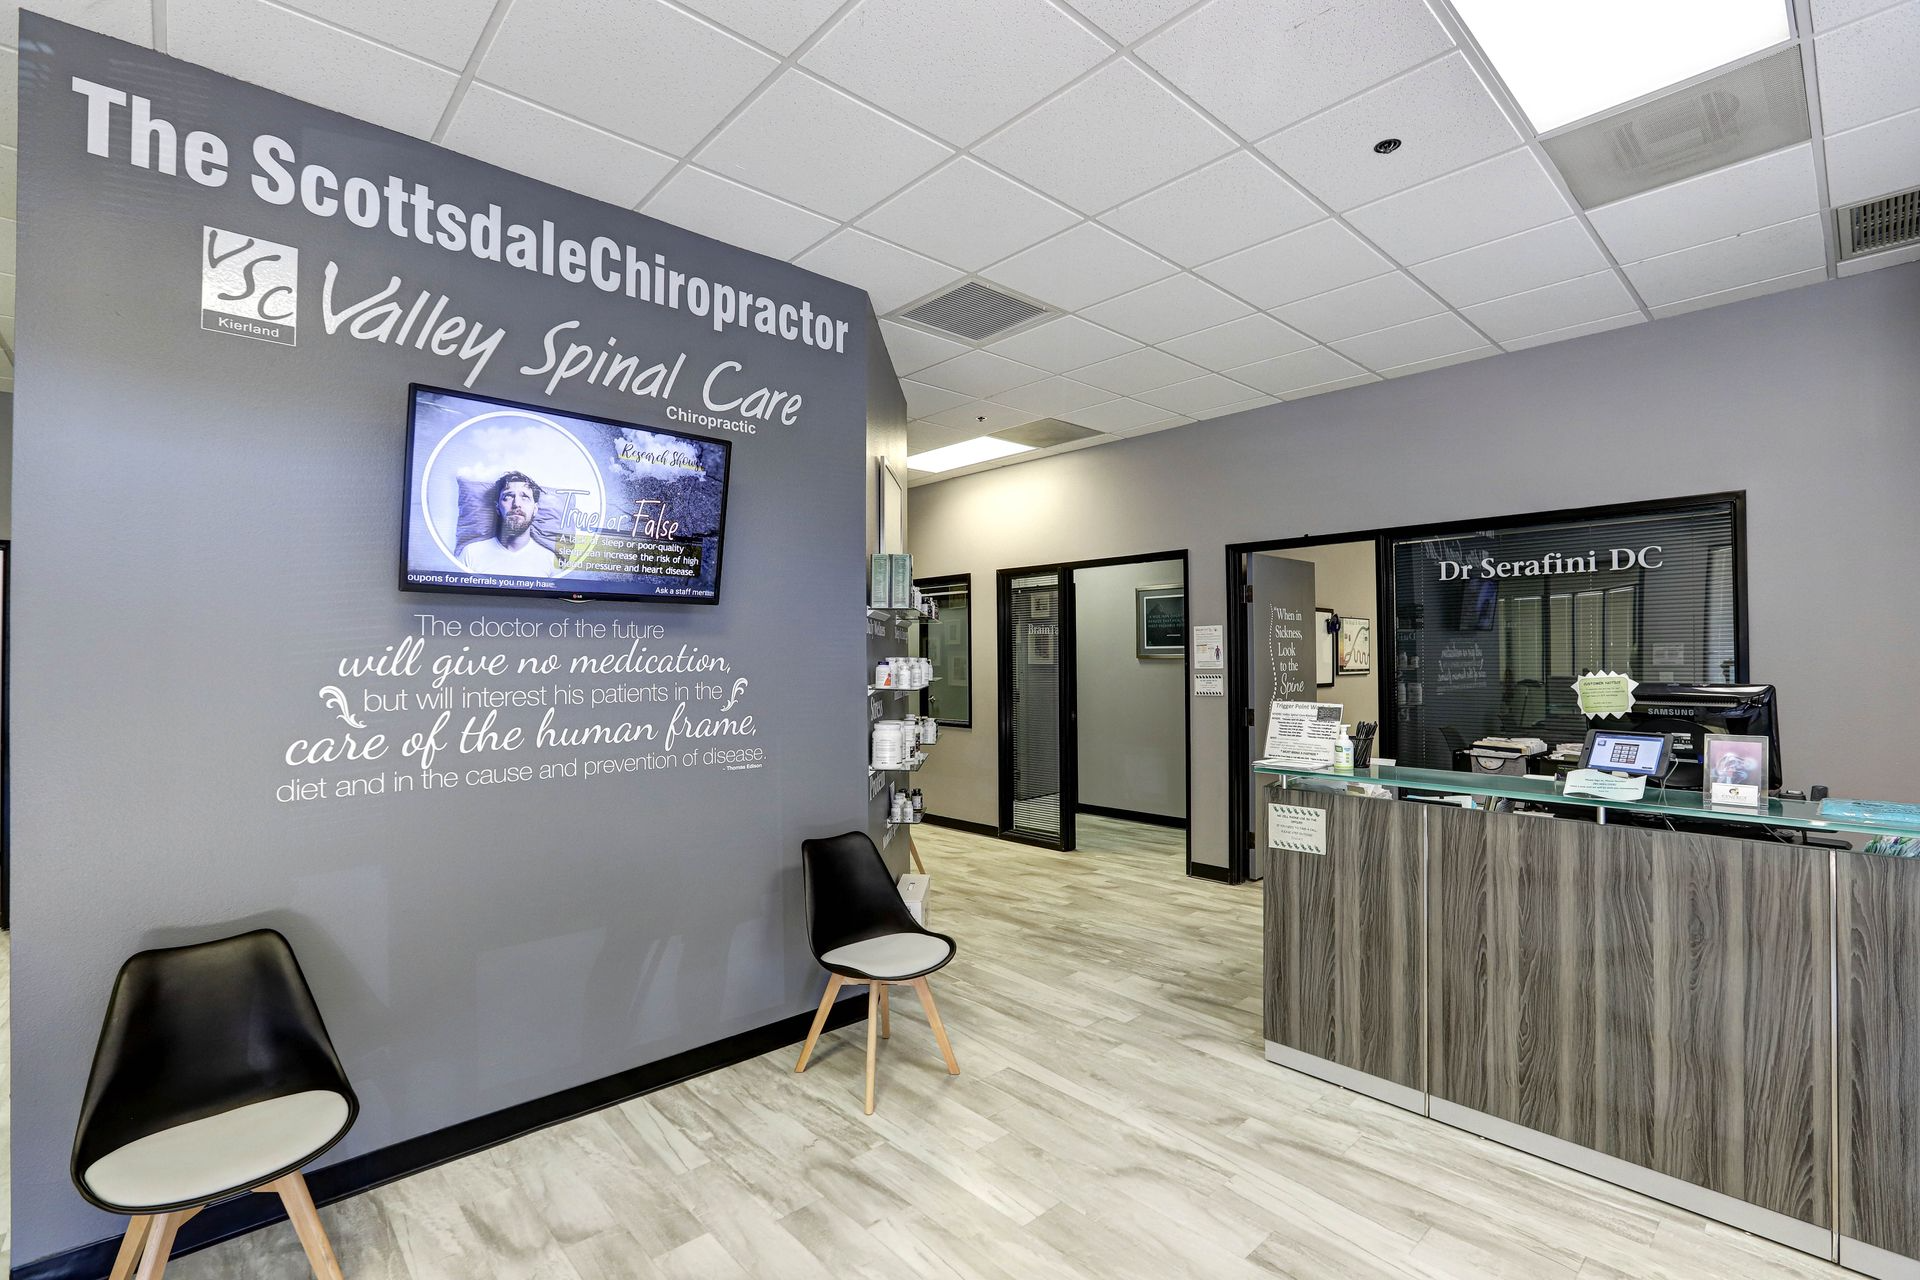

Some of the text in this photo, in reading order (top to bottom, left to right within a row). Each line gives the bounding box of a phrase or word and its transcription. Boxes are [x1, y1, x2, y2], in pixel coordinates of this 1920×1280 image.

[71, 75, 229, 188] The
[218, 317, 280, 338] Kierland
[322, 260, 803, 426] Valley Spinal Care
[666, 405, 757, 435] Chiropractic
[621, 443, 669, 466] Research
[556, 489, 680, 541] True or False
[602, 538, 624, 550] sleep
[627, 541, 635, 549] or
[637, 540, 685, 555] poor-quality
[586, 562, 621, 573] pressure
[624, 563, 640, 572] and
[642, 563, 664, 574] heart
[665, 565, 695, 577] disease.
[604, 550, 638, 561] increase
[641, 552, 653, 562] the
[656, 553, 671, 563] risk
[673, 555, 682, 564] of
[683, 555, 699, 567] high
[1438, 560, 1472, 581] Dr
[1481, 550, 1598, 579] Serafini
[1609, 545, 1664, 573] DC
[445, 574, 459, 584] for
[460, 575, 497, 586] referrals
[499, 580, 514, 588] you
[516, 580, 537, 589] may
[655, 586, 669, 595] Ask
[675, 587, 692, 596] staff
[414, 614, 665, 639] The doctor of the future
[1296, 609, 1302, 621] in
[1275, 624, 1303, 641] Sickness,
[1278, 641, 1296, 657] Look
[338, 635, 731, 689] will give no medication,
[1280, 657, 1299, 672] to the
[364, 681, 723, 713] but will interest his patients in the
[1280, 672, 1305, 700] Spine
[1647, 708, 1695, 716] SAMSUNG
[285, 701, 757, 770] care of the human frame,
[276, 747, 767, 803] diet and in the cause and prevention of disease.
